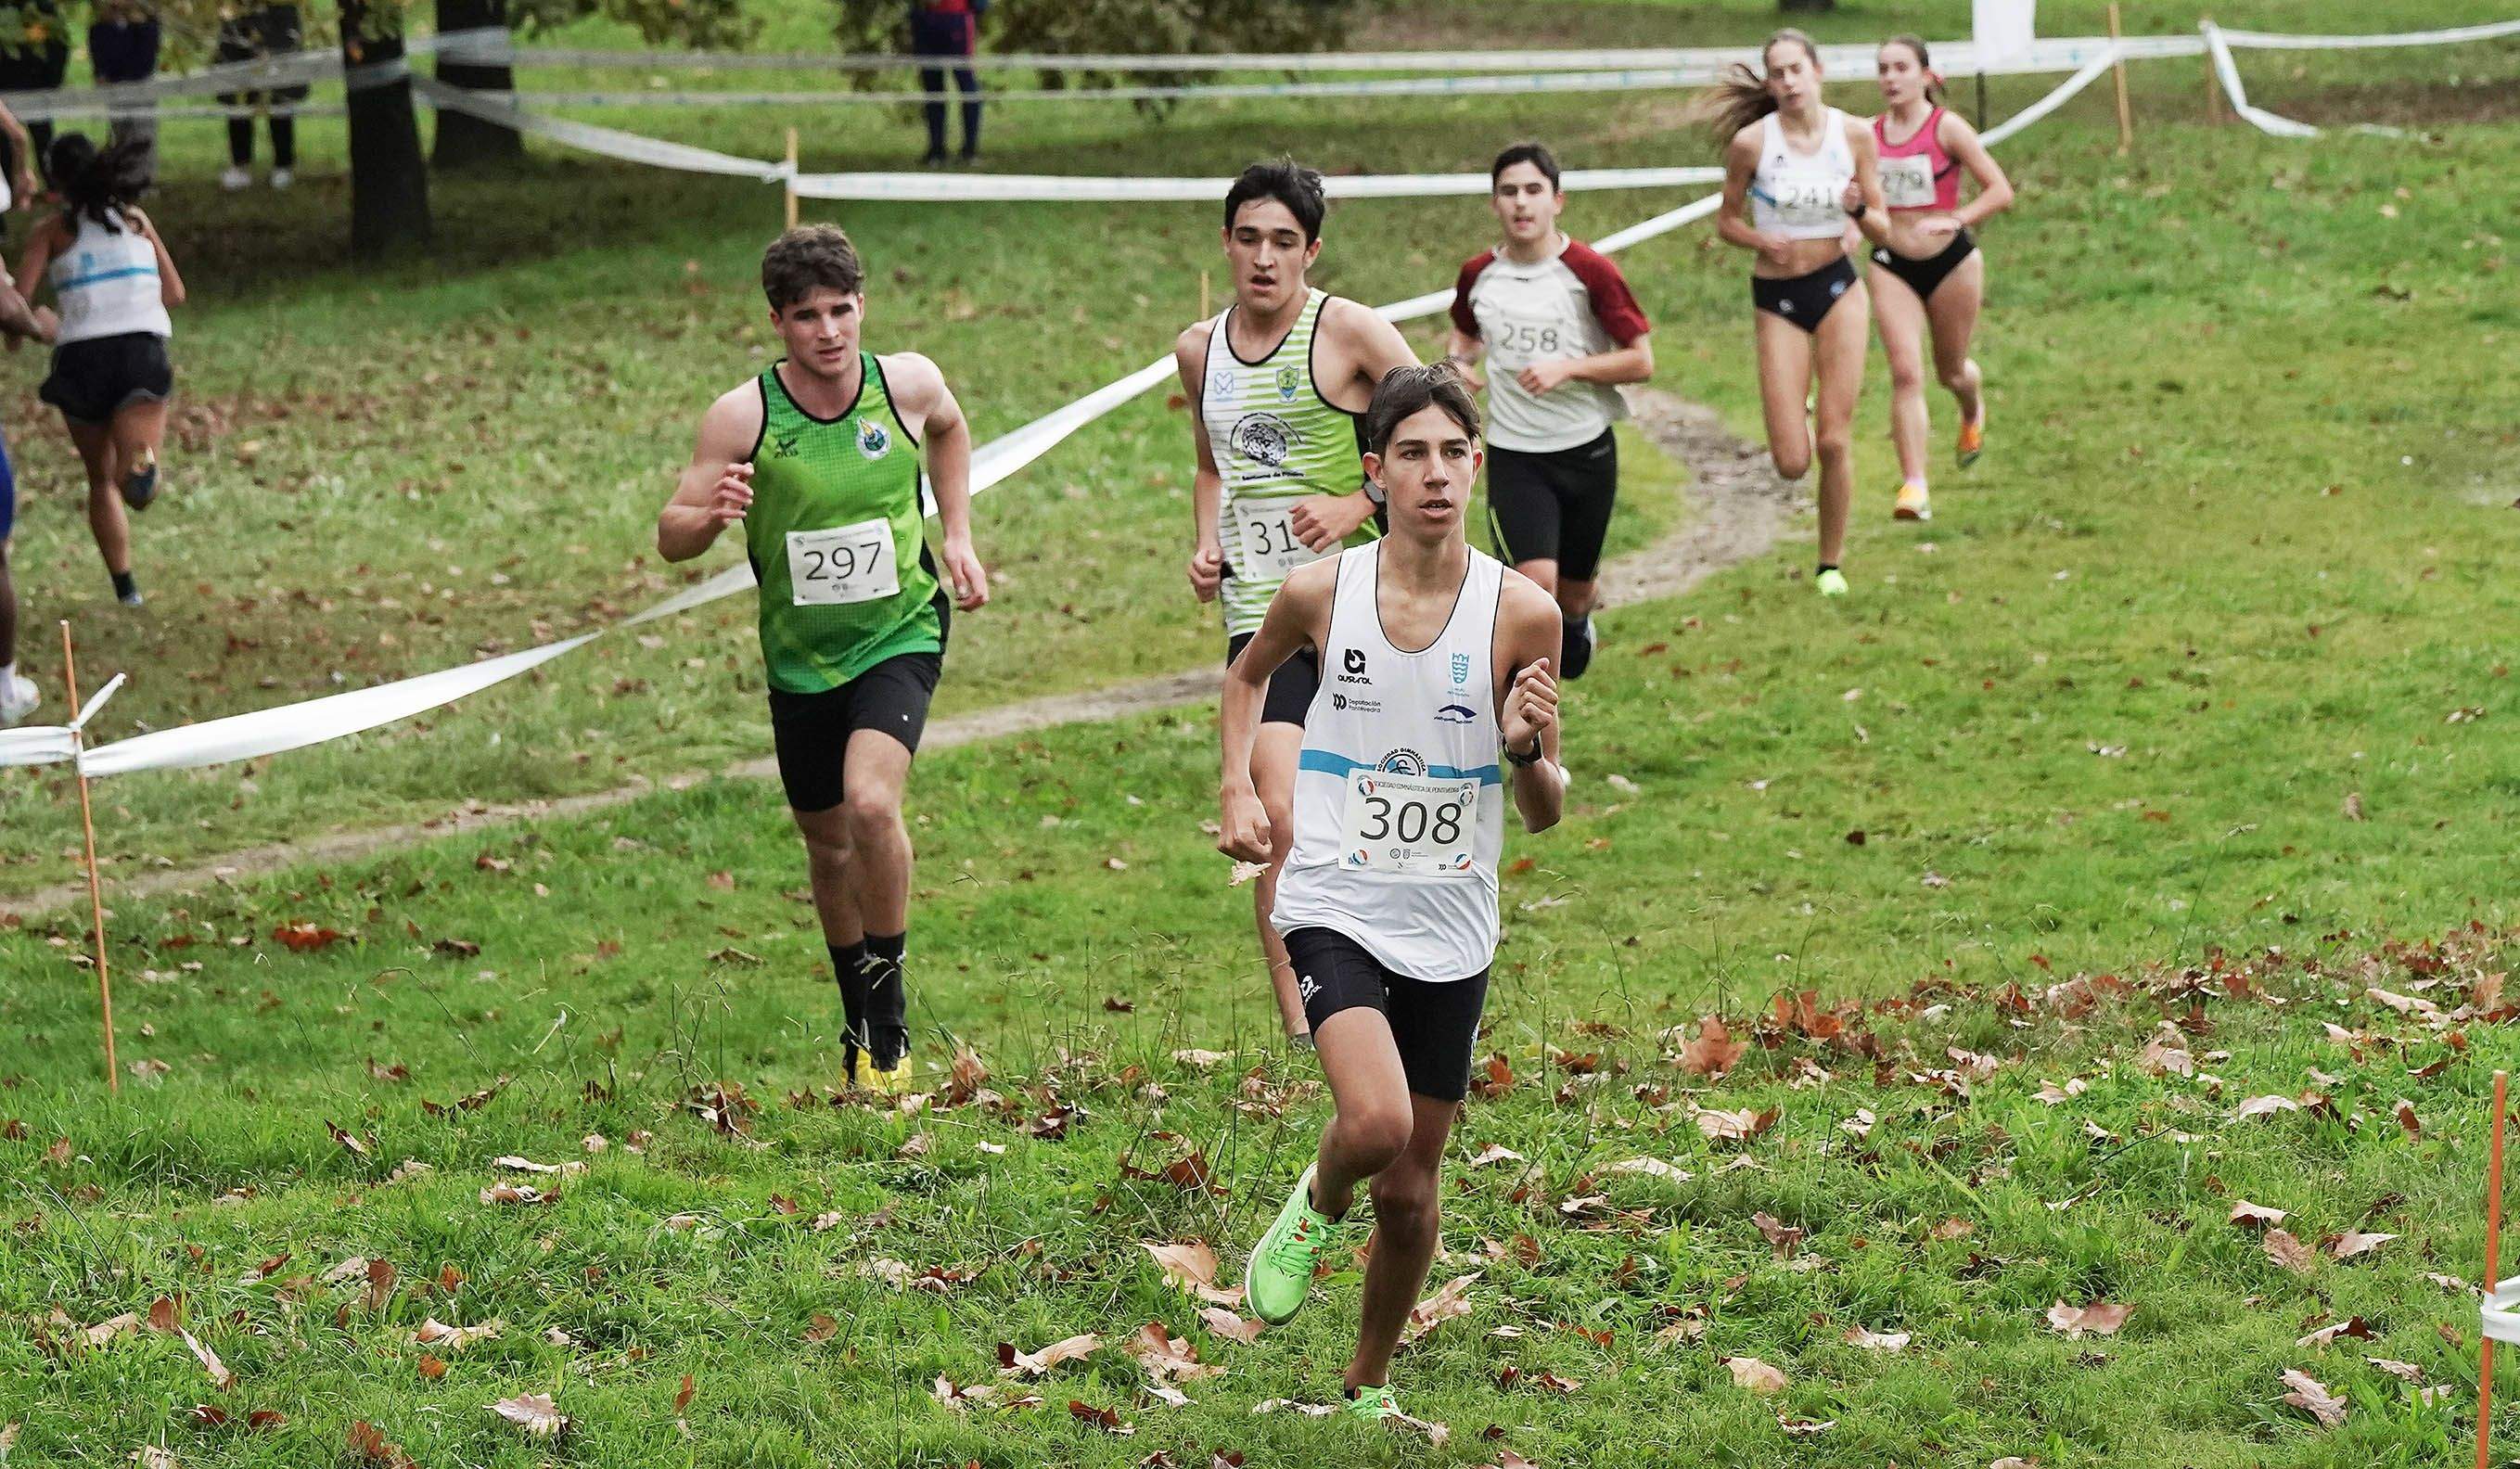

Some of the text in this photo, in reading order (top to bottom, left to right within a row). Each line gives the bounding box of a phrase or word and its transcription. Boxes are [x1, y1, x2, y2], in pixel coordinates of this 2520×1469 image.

[1784, 185, 1835, 210] 241
[1499, 322, 1558, 353] 258
[1250, 519, 1298, 555] 31
[803, 542, 881, 581] 297
[1376, 748, 1399, 772] SOCIEDAD
[1359, 797, 1463, 845] 308
